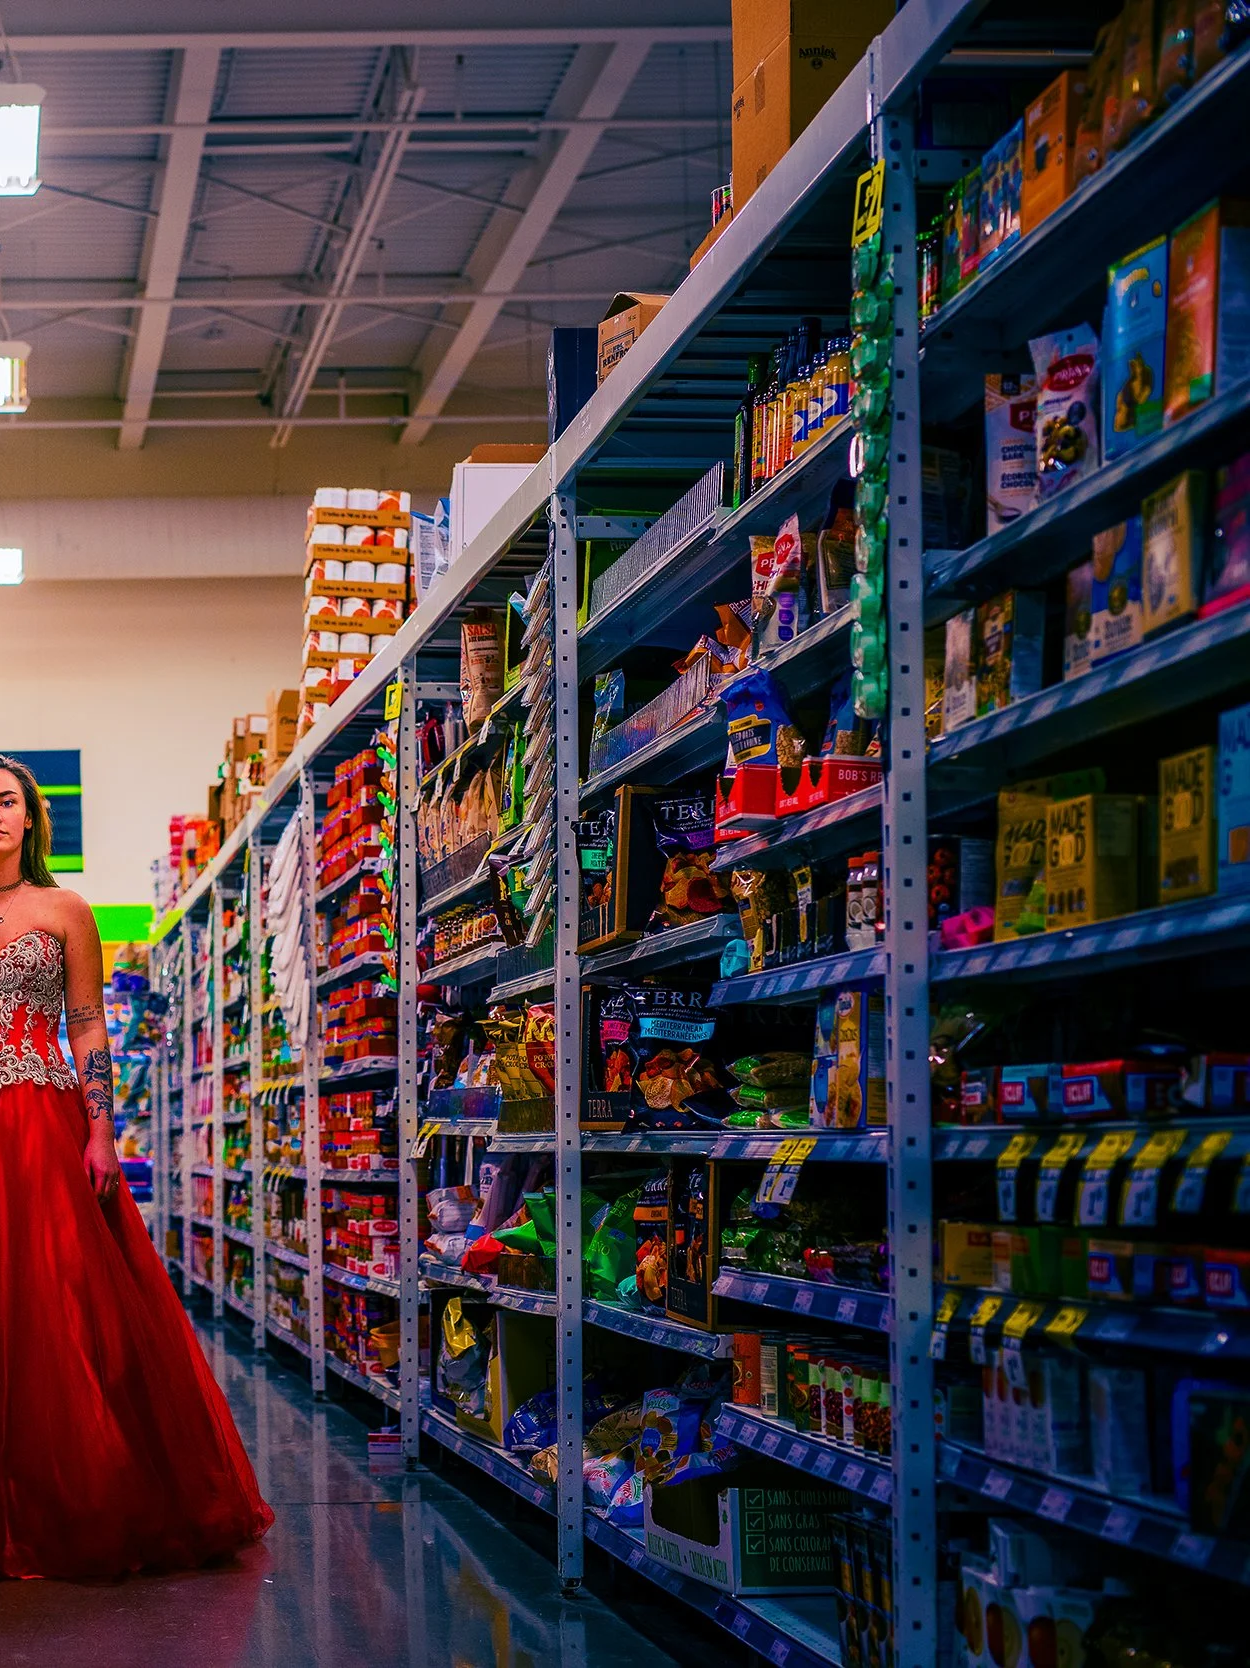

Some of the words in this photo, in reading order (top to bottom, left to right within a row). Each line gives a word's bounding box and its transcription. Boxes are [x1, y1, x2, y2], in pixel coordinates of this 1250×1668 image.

[798, 44, 838, 60] Annie's
[467, 623, 497, 637] SALSA
[838, 769, 868, 781] BOB'S
[1051, 801, 1086, 834] MADE
[588, 1099, 613, 1118] TERRA
[767, 1489, 793, 1506] SANS
[768, 1512, 793, 1530] SANS
[795, 1512, 820, 1529] GRAS
[769, 1534, 794, 1552] SANS
[769, 1556, 781, 1573] DE
